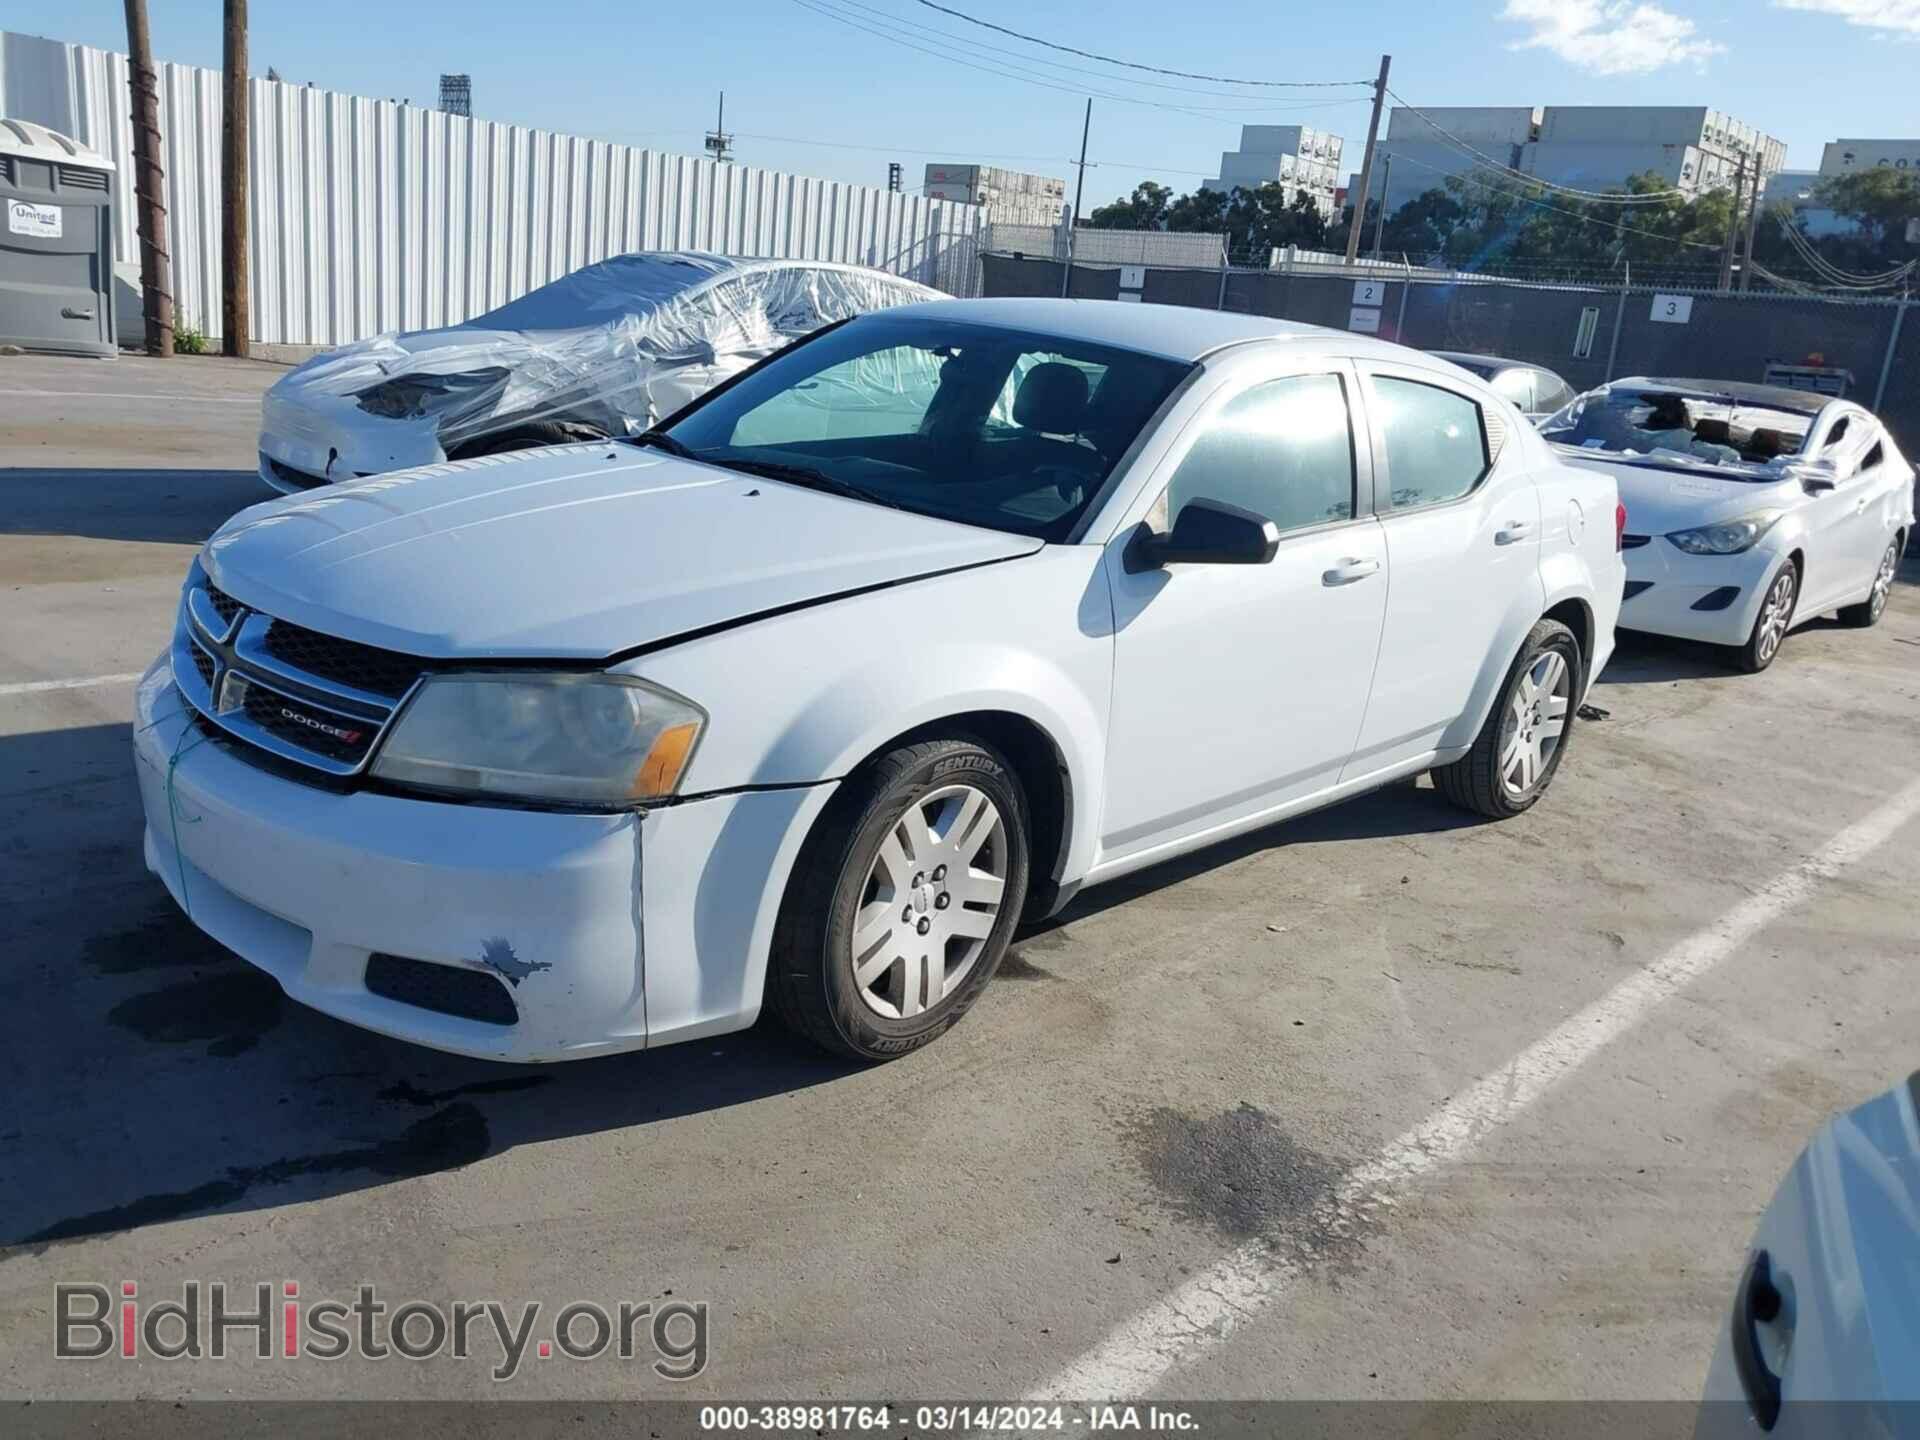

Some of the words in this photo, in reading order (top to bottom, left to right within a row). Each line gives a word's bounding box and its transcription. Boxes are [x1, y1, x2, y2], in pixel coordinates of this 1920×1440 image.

[16, 207, 56, 222] United
[1364, 287, 1374, 300] 2
[1666, 302, 1677, 316] 3
[280, 707, 350, 740] DODGE
[933, 755, 1004, 777] SENTURY
